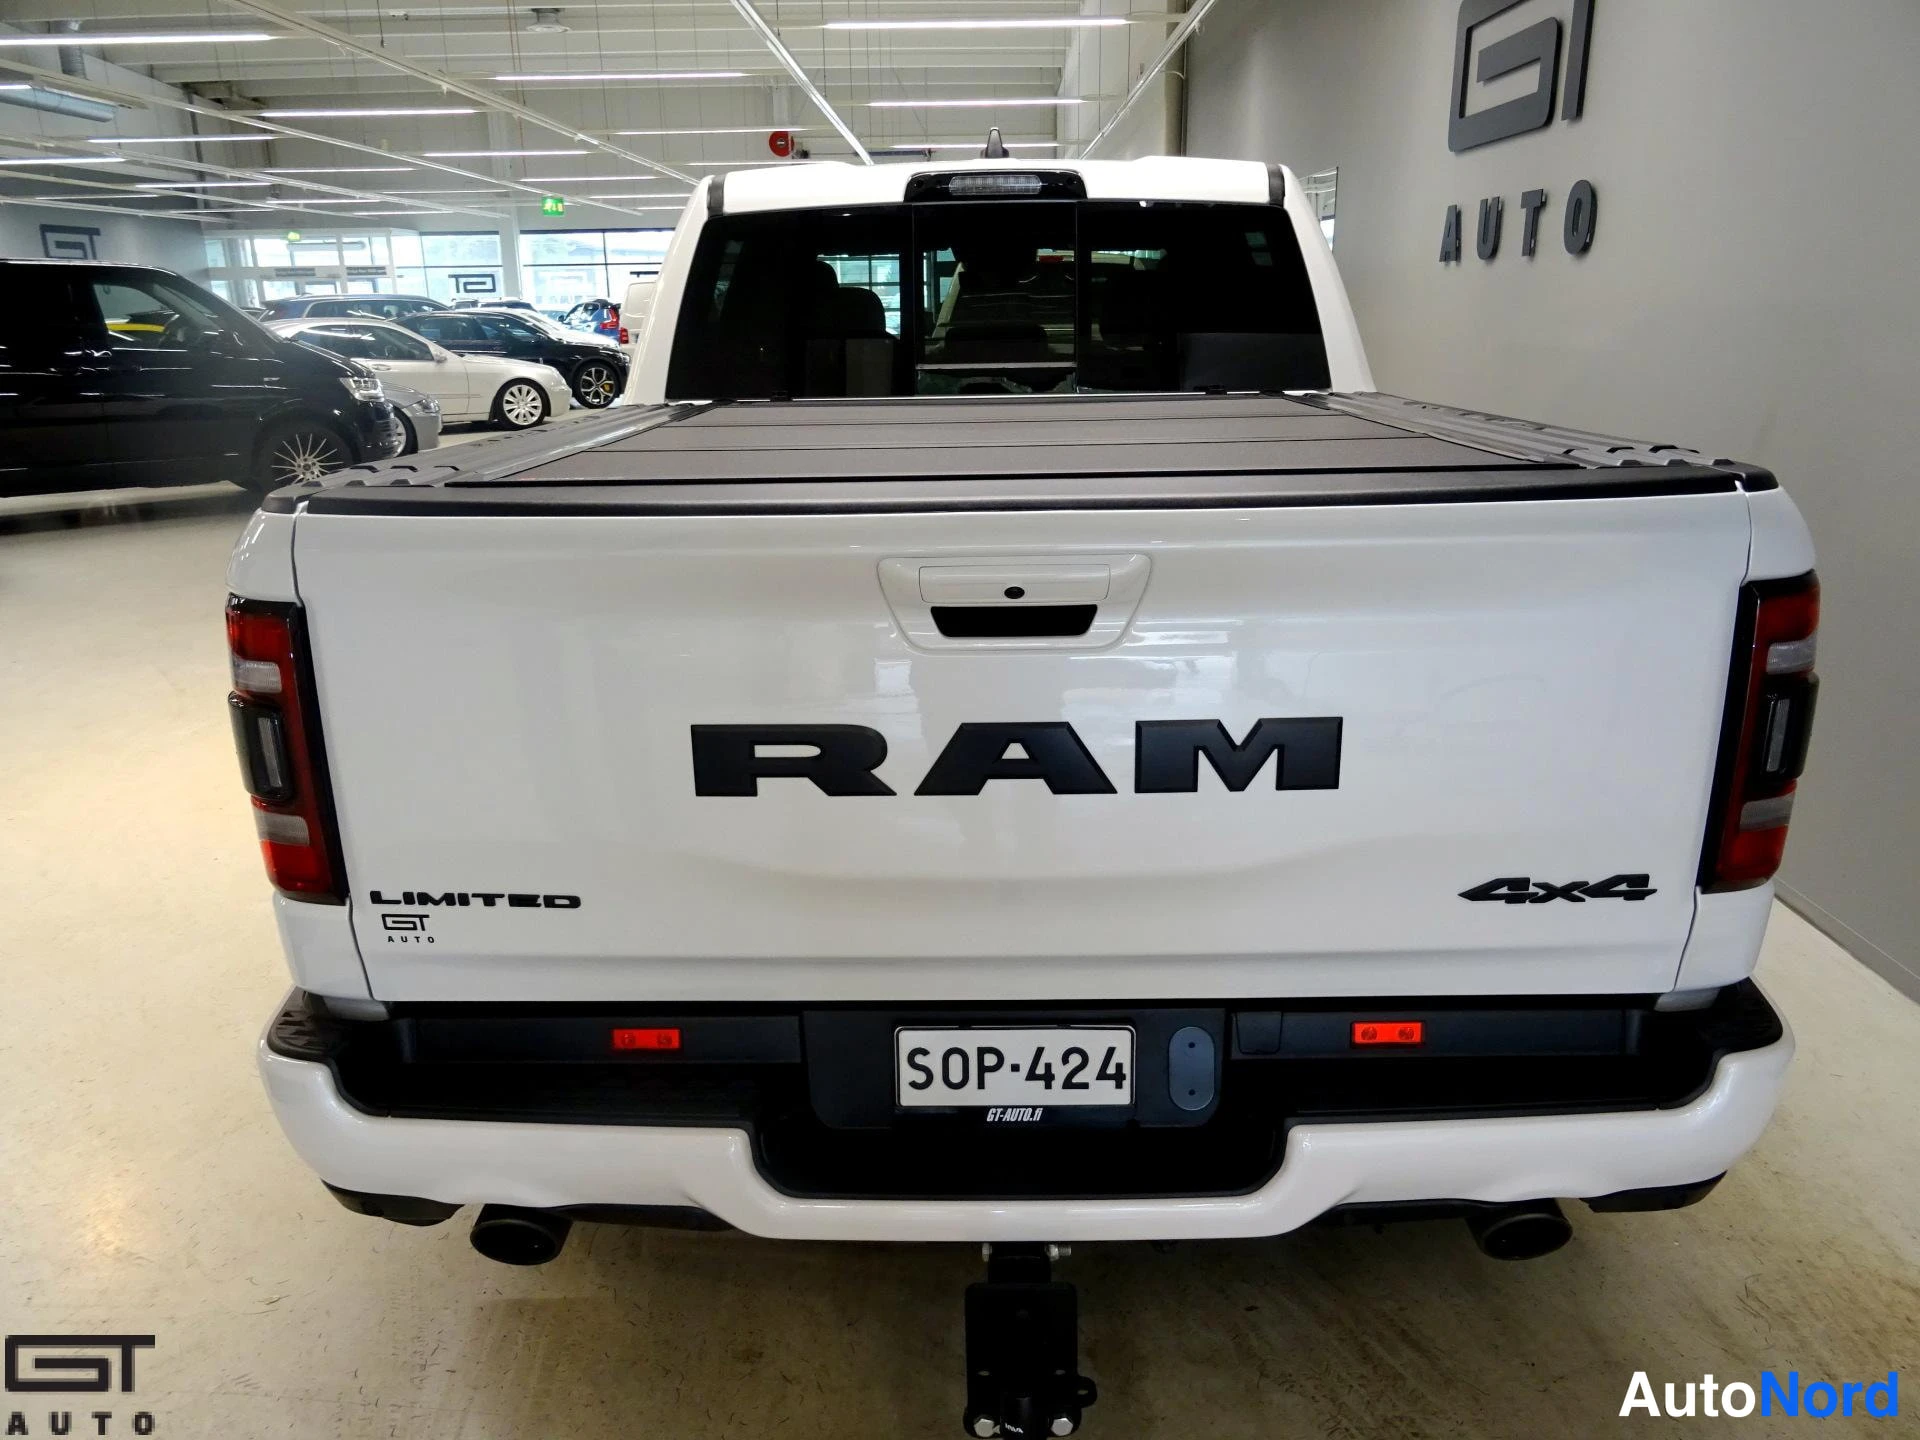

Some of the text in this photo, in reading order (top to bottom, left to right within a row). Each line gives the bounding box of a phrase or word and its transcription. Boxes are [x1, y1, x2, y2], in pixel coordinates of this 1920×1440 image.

[1438, 179, 1598, 263] AUTO
[690, 716, 1343, 797] RAM
[369, 890, 582, 909] LIMITED
[1457, 873, 1658, 904] 4x4
[381, 913, 430, 932] GT
[387, 935, 435, 944] AUTO
[907, 1046, 1127, 1090] SOP-424
[986, 1107, 1043, 1123] GT-AUTO.fi
